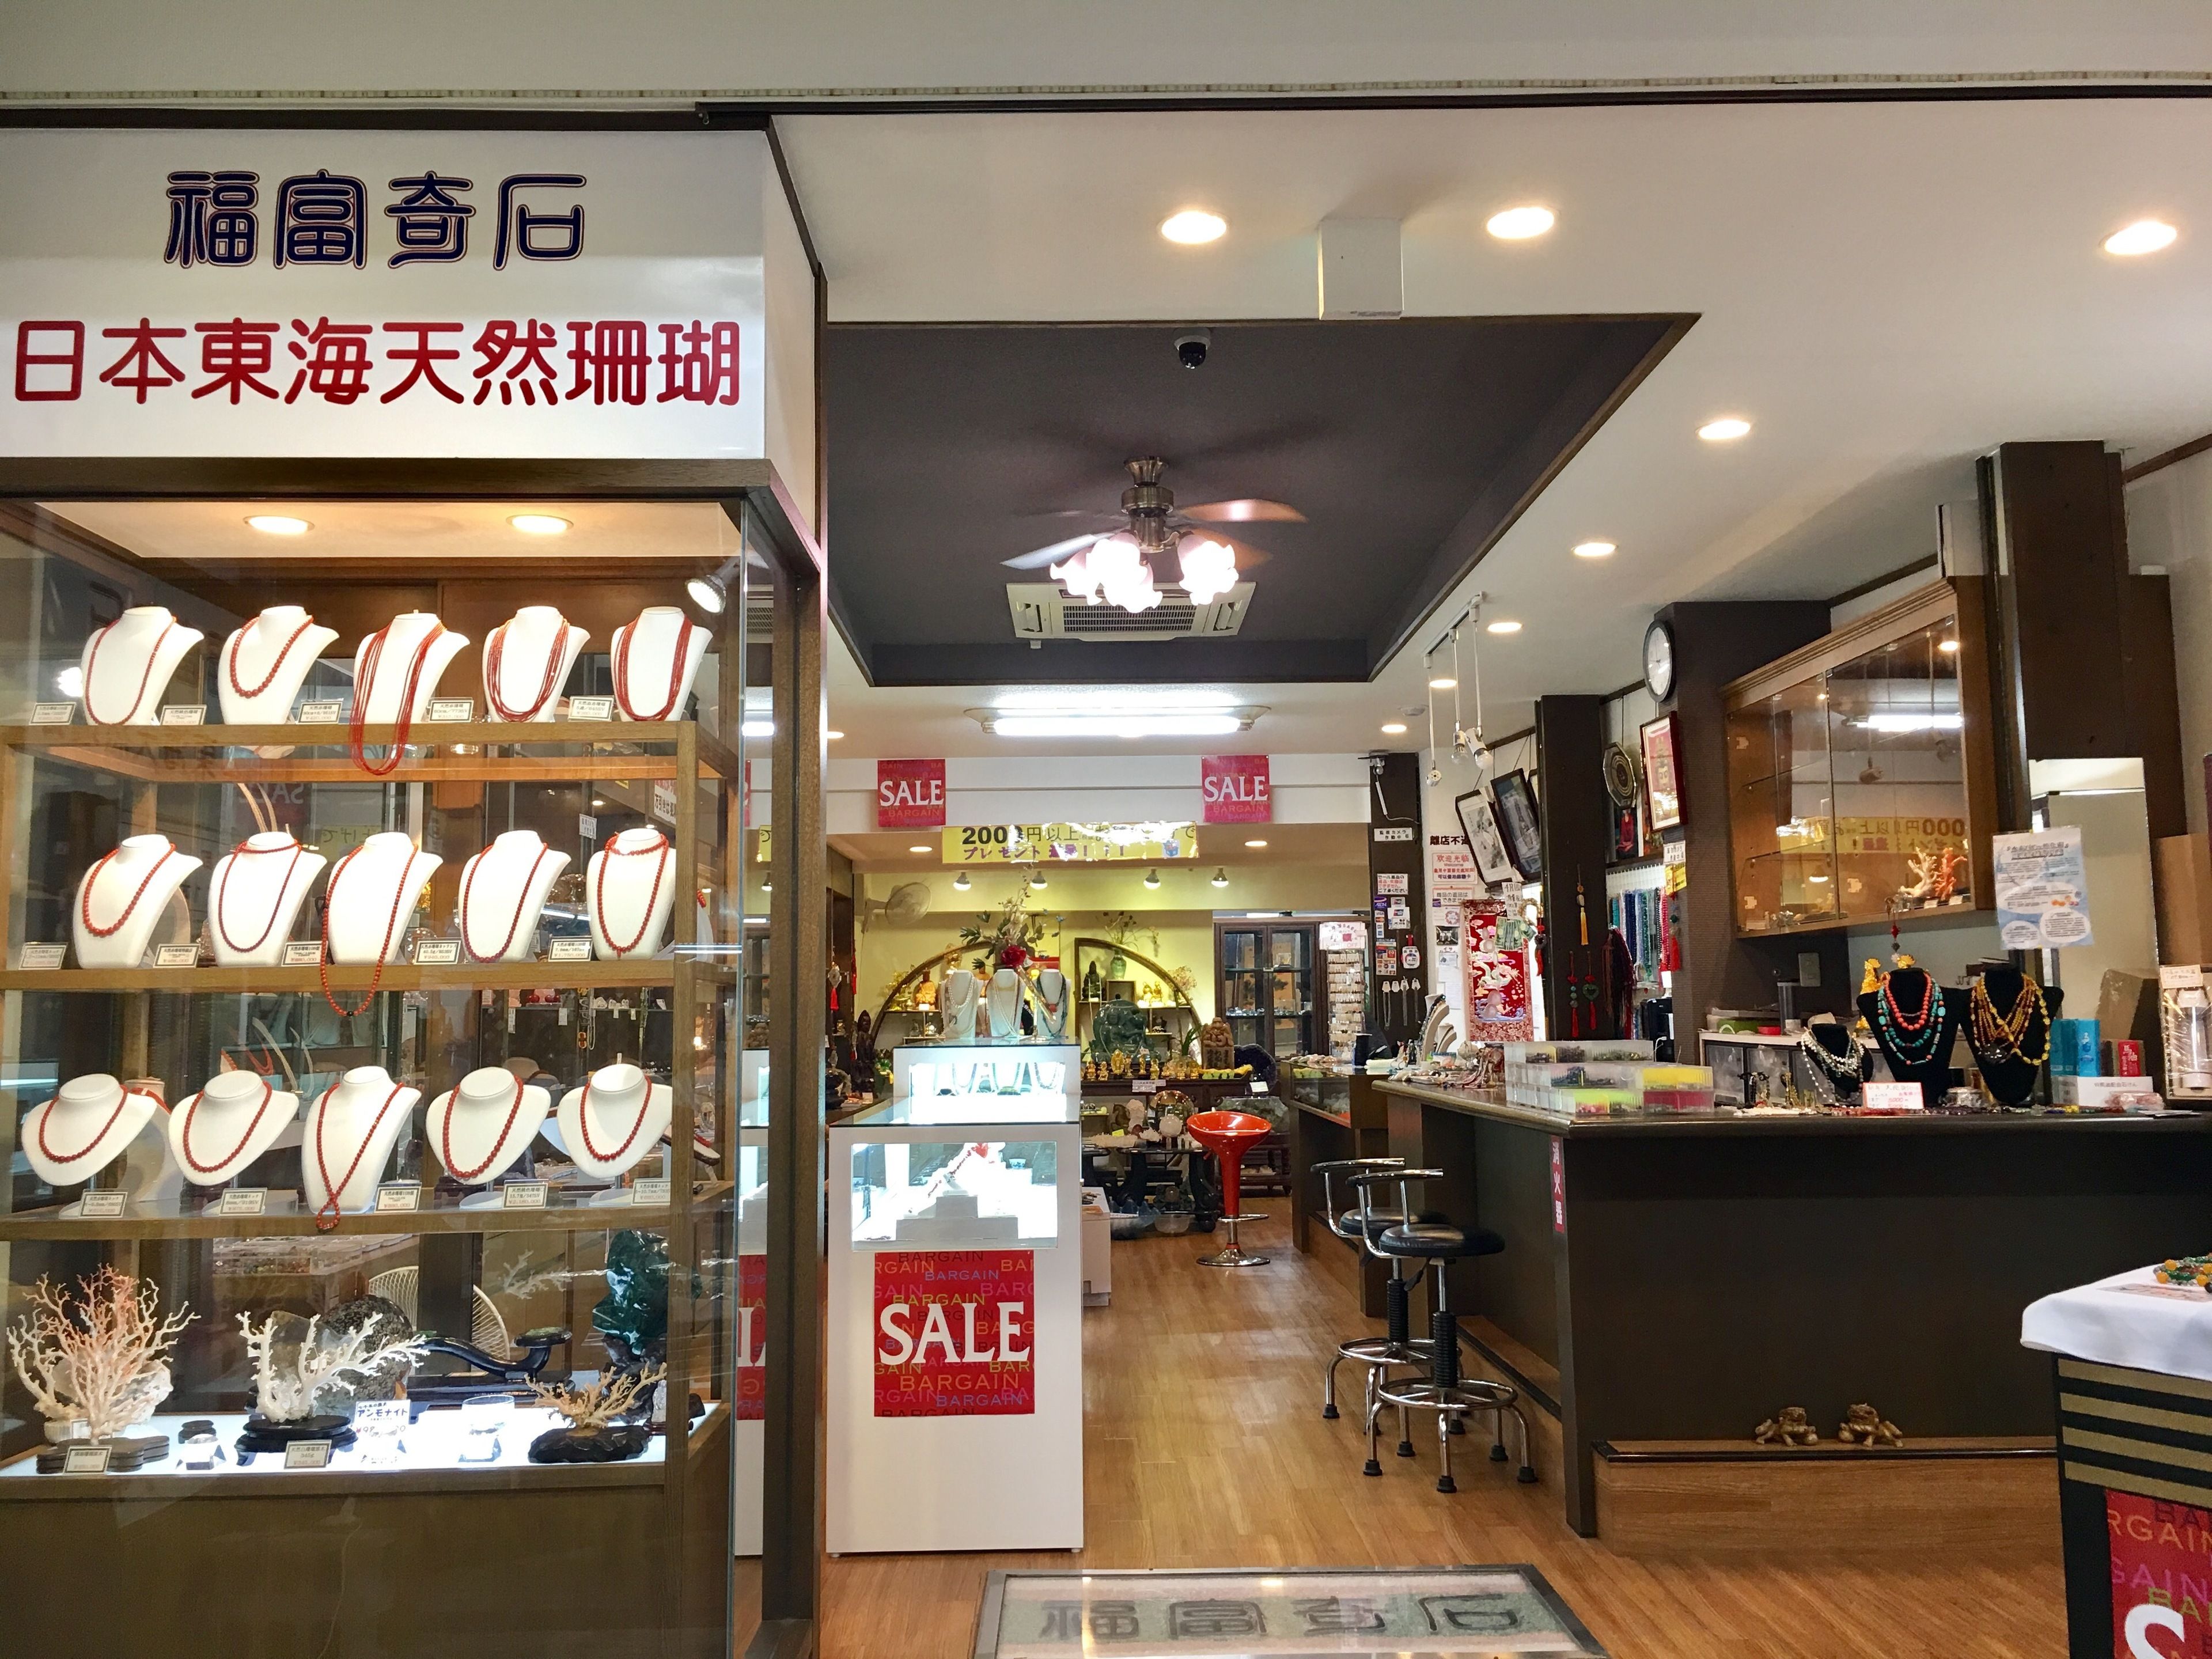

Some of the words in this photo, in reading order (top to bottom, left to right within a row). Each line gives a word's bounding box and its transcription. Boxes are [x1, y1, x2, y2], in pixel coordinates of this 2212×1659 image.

[164, 169, 587, 270] 福富奇石
[15, 316, 740, 406] 日本東海天然珊瑚
[880, 780, 944, 806] SALE
[1204, 776, 1268, 802] SALE
[898, 1251, 984, 1263] BARGAIN
[925, 1270, 999, 1281] BARGAIN
[893, 1293, 985, 1306] BARGAIN
[878, 1301, 1031, 1365] SALE
[900, 1374, 1019, 1392] BARGAIN
[935, 1394, 1023, 1407] BARGAIN
[358, 1408, 408, 1418] アンモナイト
